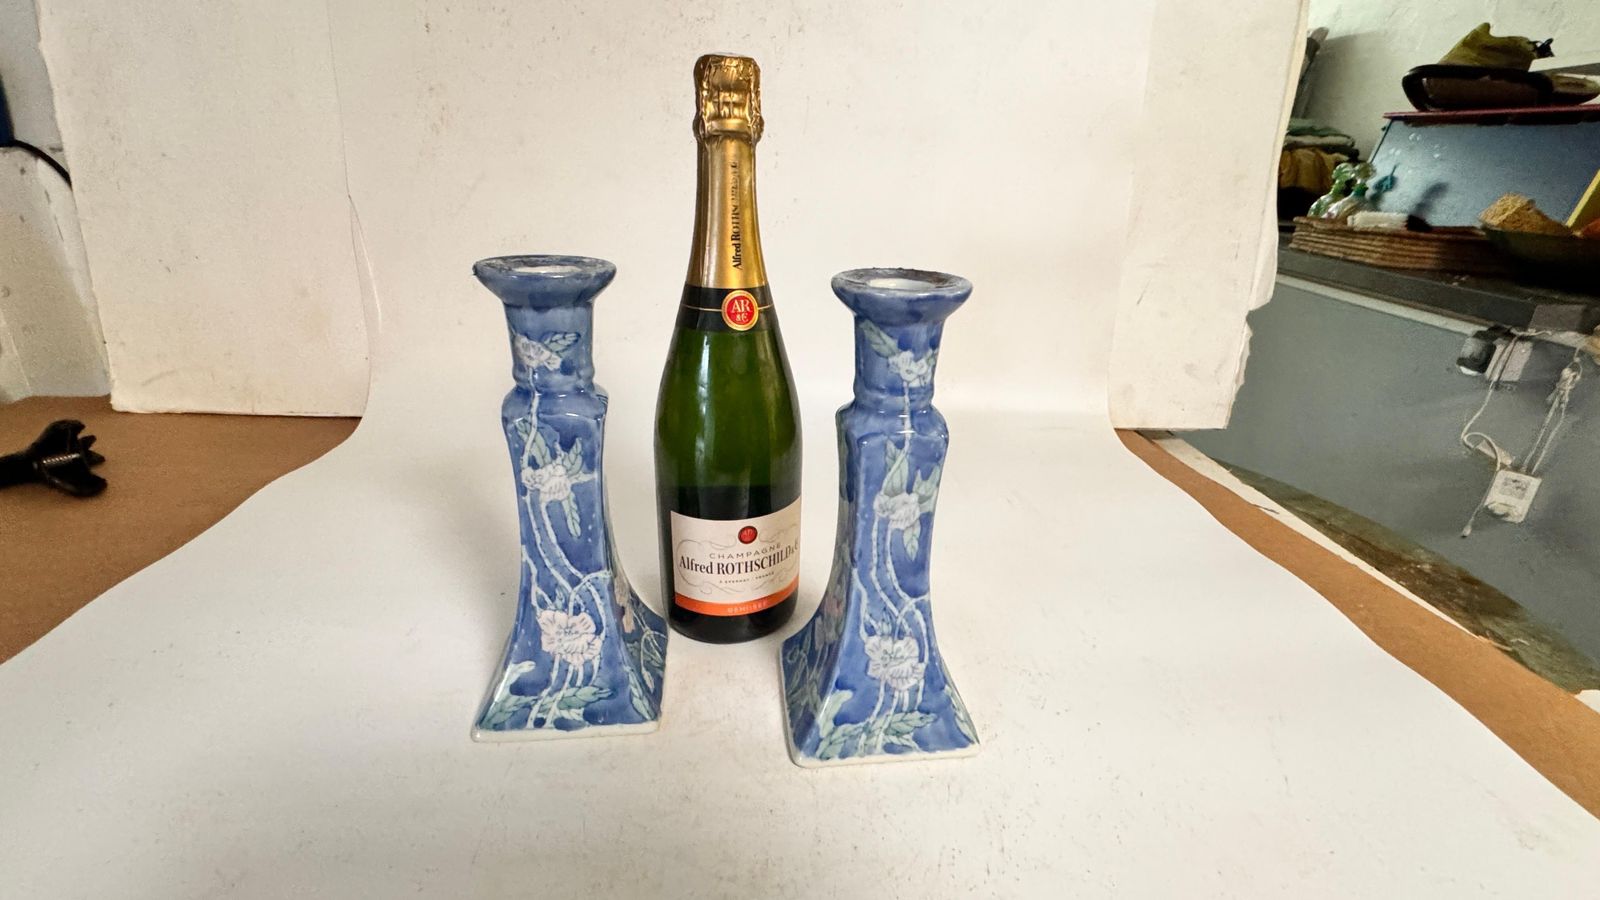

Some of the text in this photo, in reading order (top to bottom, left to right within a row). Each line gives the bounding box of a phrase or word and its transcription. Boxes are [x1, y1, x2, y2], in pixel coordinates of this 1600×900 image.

[732, 243, 743, 270] Alfred
[730, 299, 753, 313] AR
[679, 555, 713, 574] Alfred
[716, 545, 791, 575] ROTHSCHILD
[709, 543, 781, 559] CHAMPAGNE
